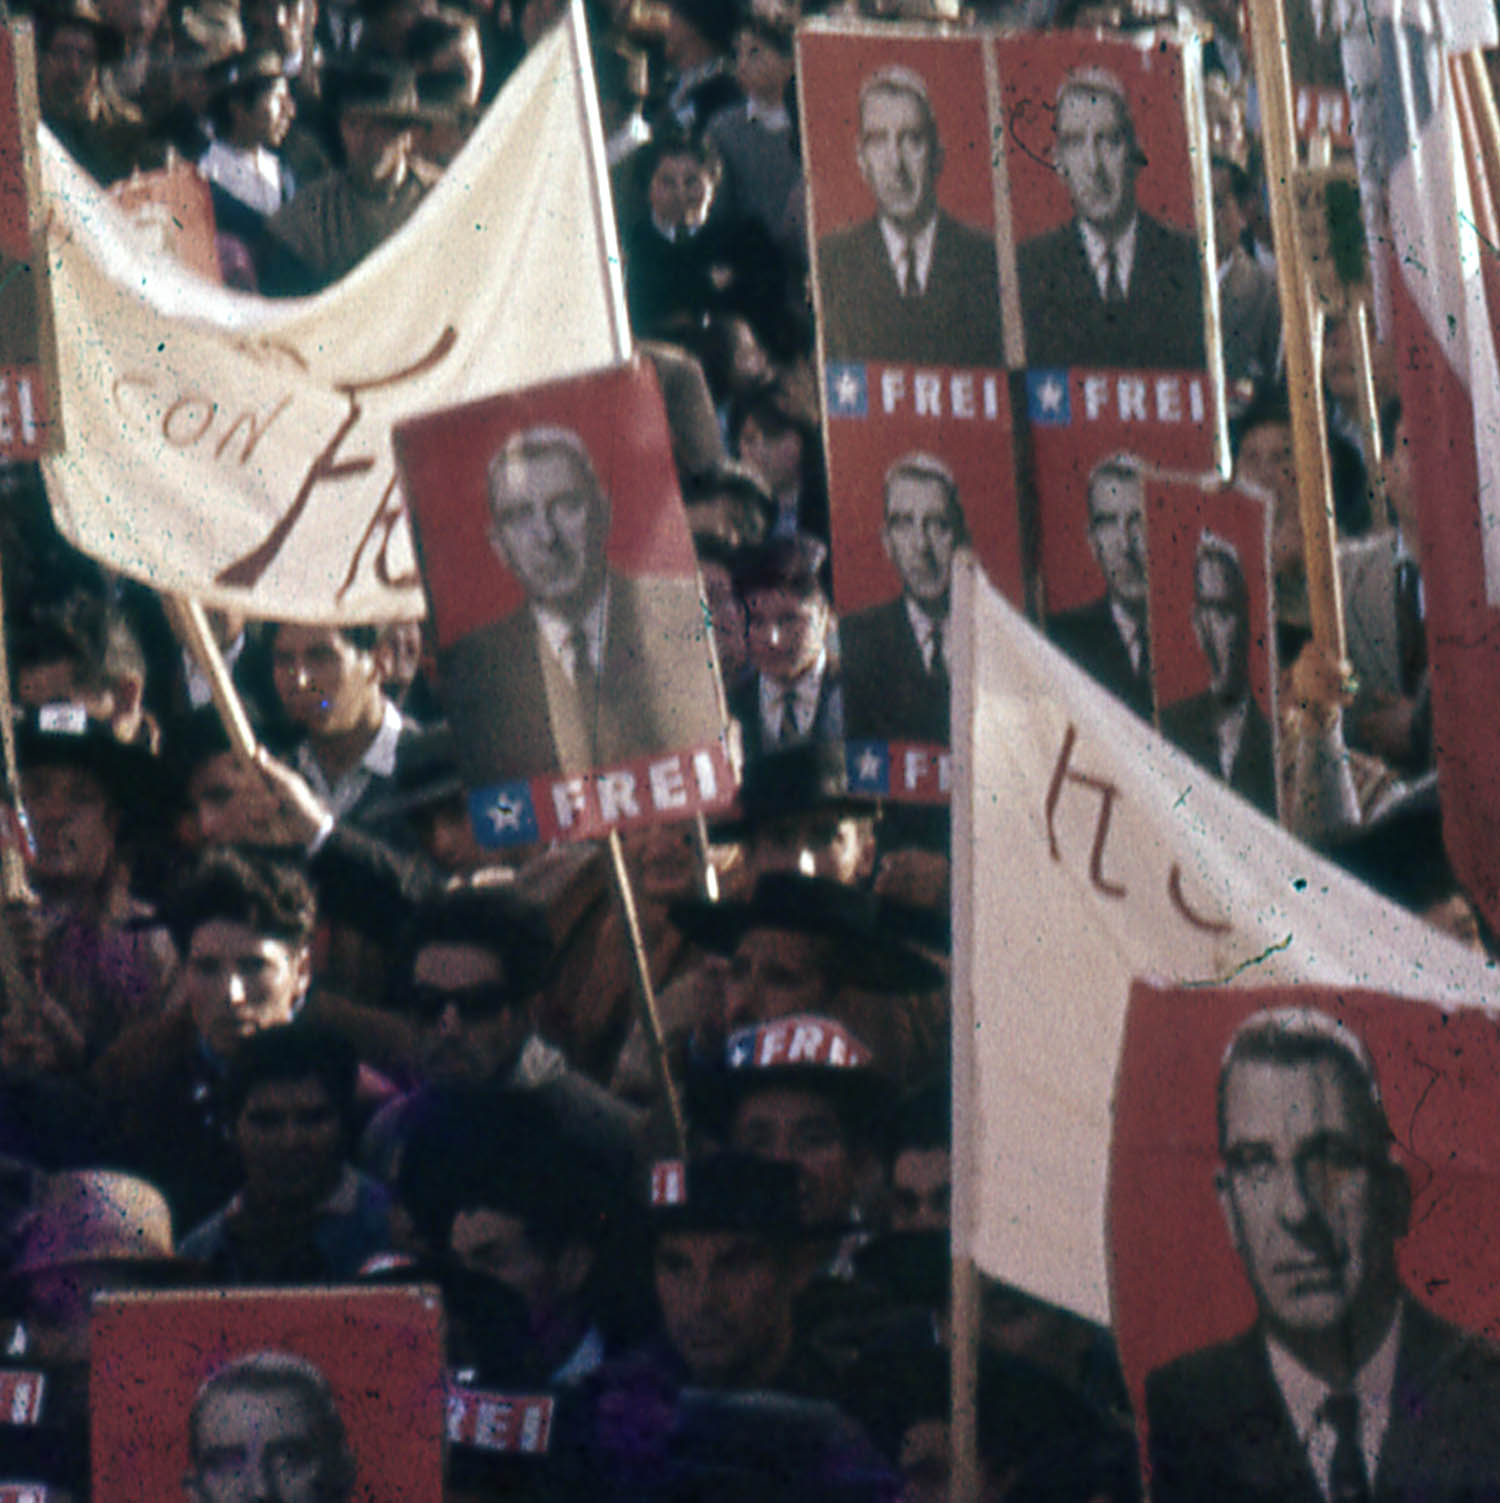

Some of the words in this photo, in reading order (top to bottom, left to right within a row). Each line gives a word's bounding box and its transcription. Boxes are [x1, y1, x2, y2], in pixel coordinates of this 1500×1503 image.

[112, 374, 294, 466] CON
[880, 371, 1000, 421] FREI
[1083, 374, 1206, 424] FREI
[550, 754, 718, 831] FREI
